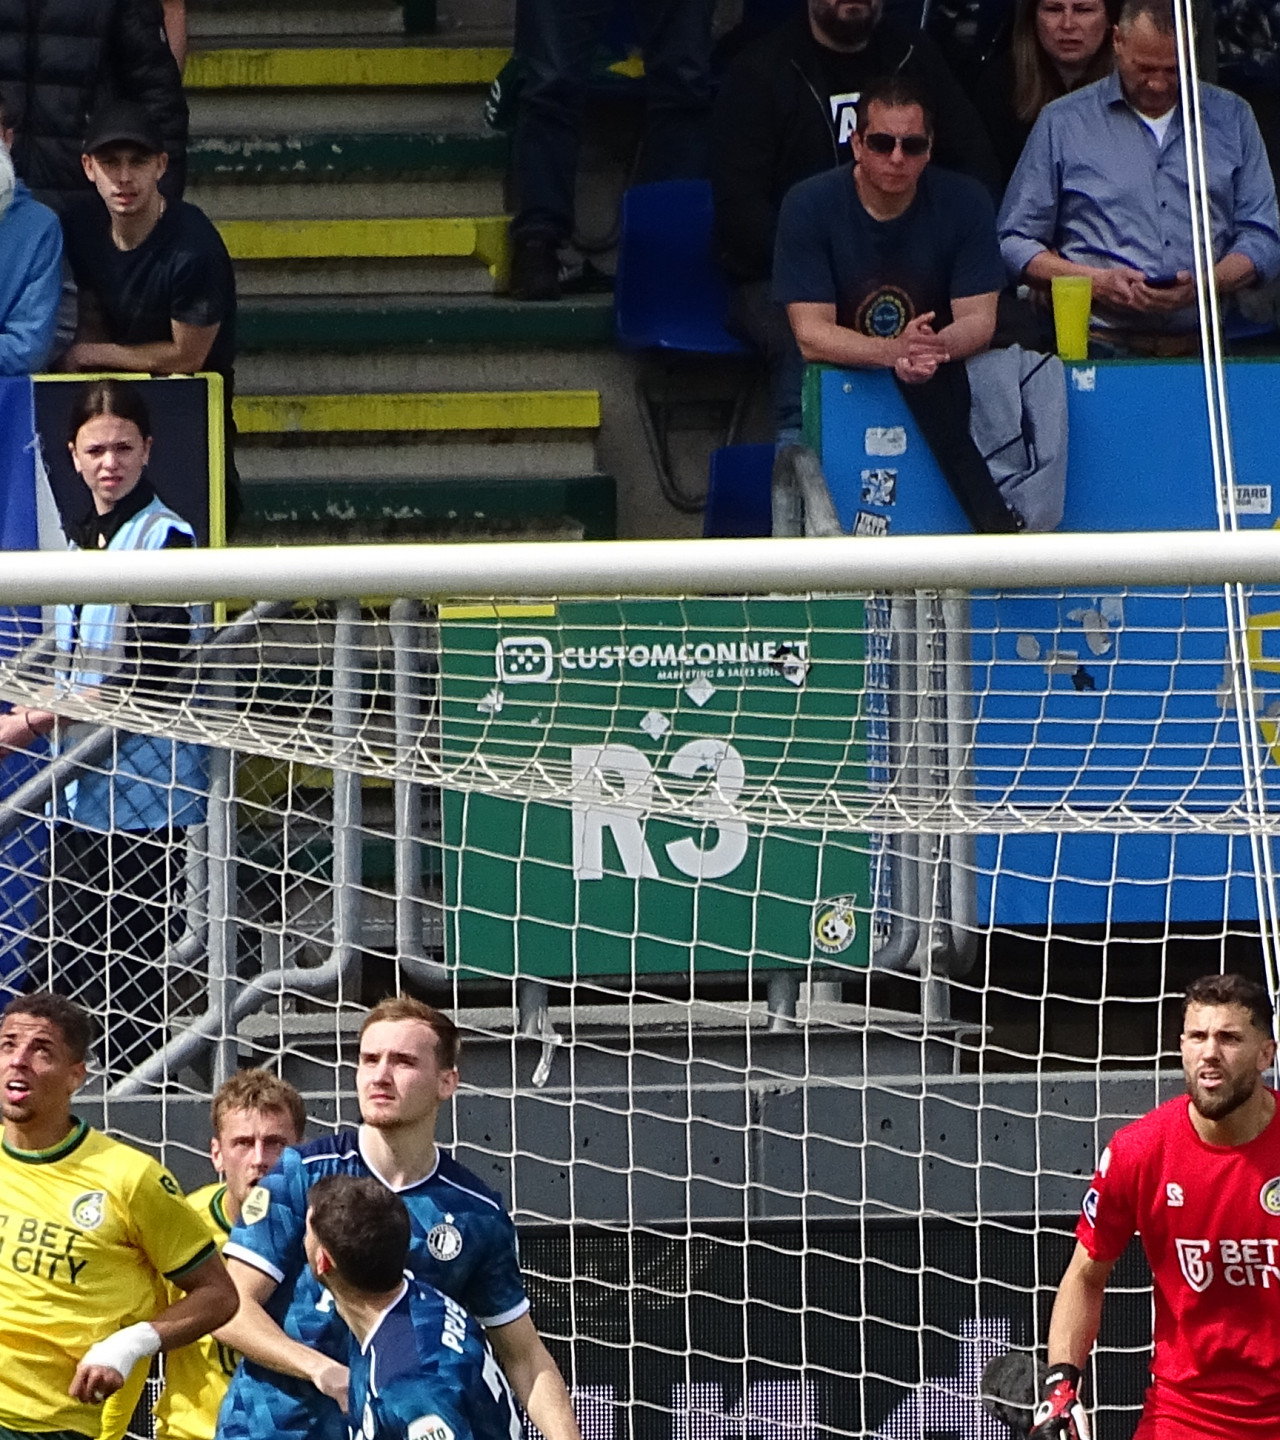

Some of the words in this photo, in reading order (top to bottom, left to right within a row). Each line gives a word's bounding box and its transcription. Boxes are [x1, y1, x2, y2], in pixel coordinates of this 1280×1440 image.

[571, 738, 749, 881] R3
[17, 1217, 84, 1254] BET
[1219, 1238, 1280, 1265] BET
[12, 1246, 89, 1285] CITY
